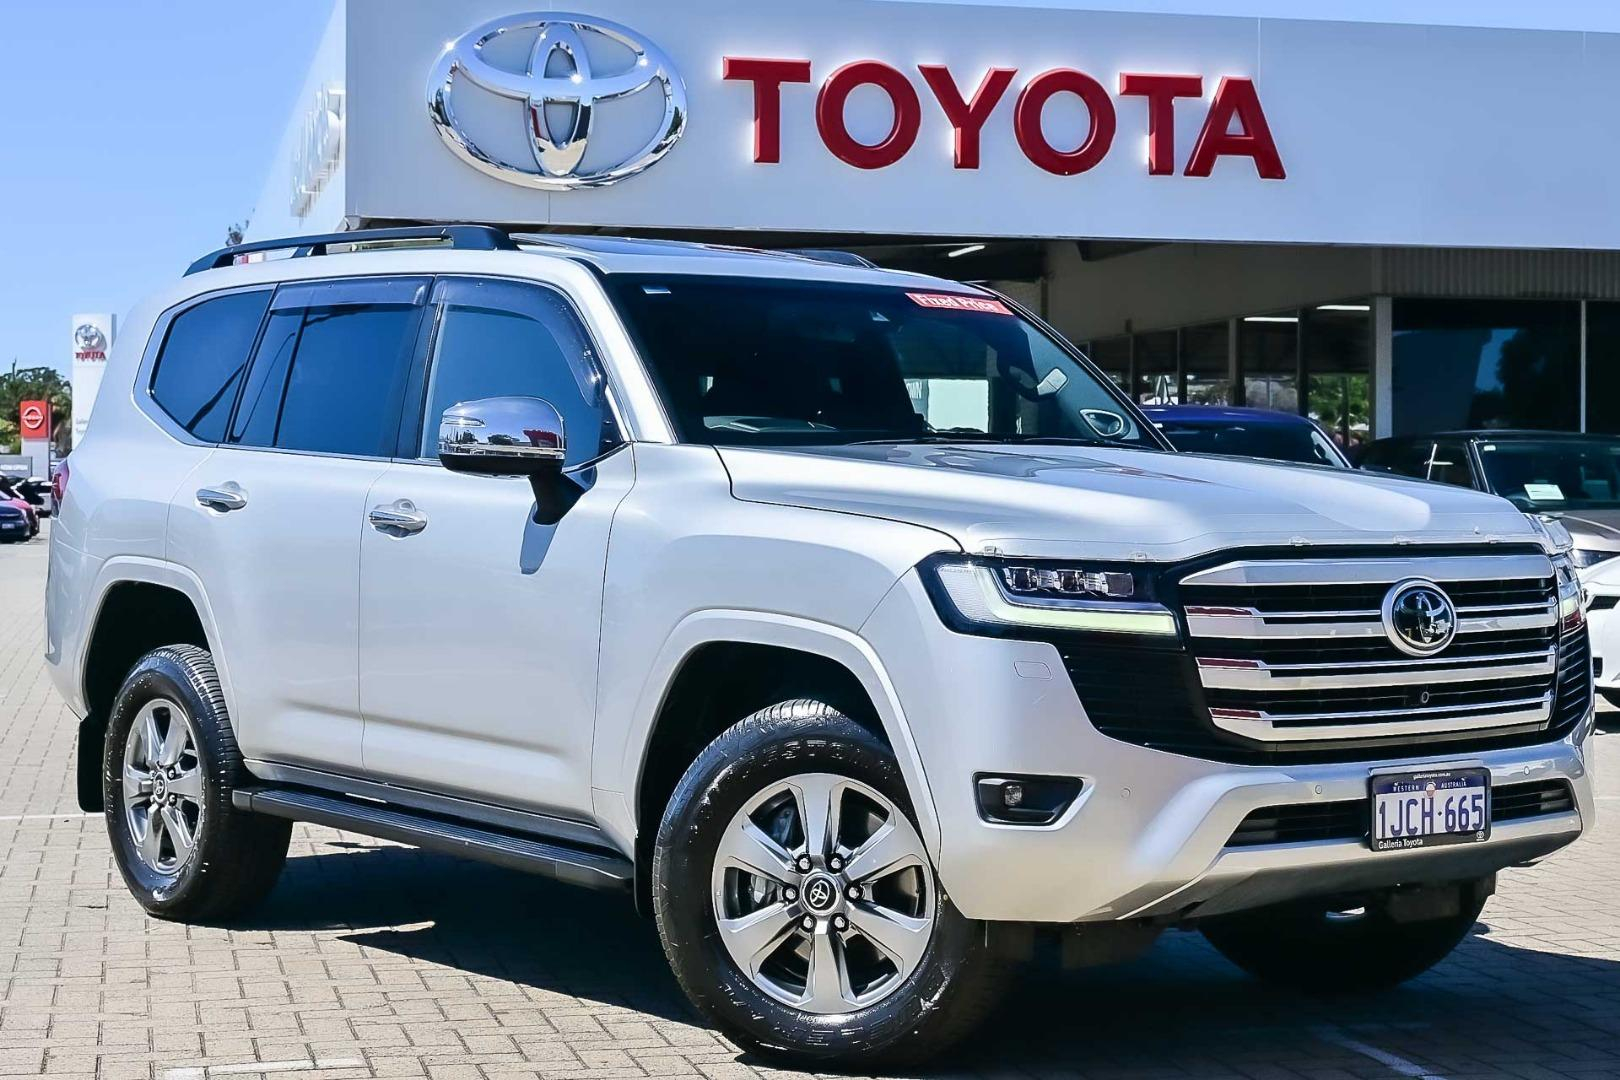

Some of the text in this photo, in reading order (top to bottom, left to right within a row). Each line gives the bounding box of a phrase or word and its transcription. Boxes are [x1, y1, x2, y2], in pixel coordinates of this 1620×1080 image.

[722, 56, 1287, 180] TOYOTA
[914, 294, 960, 307] Fixed
[1441, 781, 1467, 789] AUSTRALIA
[1378, 838, 1423, 849] Galleria Toyota
